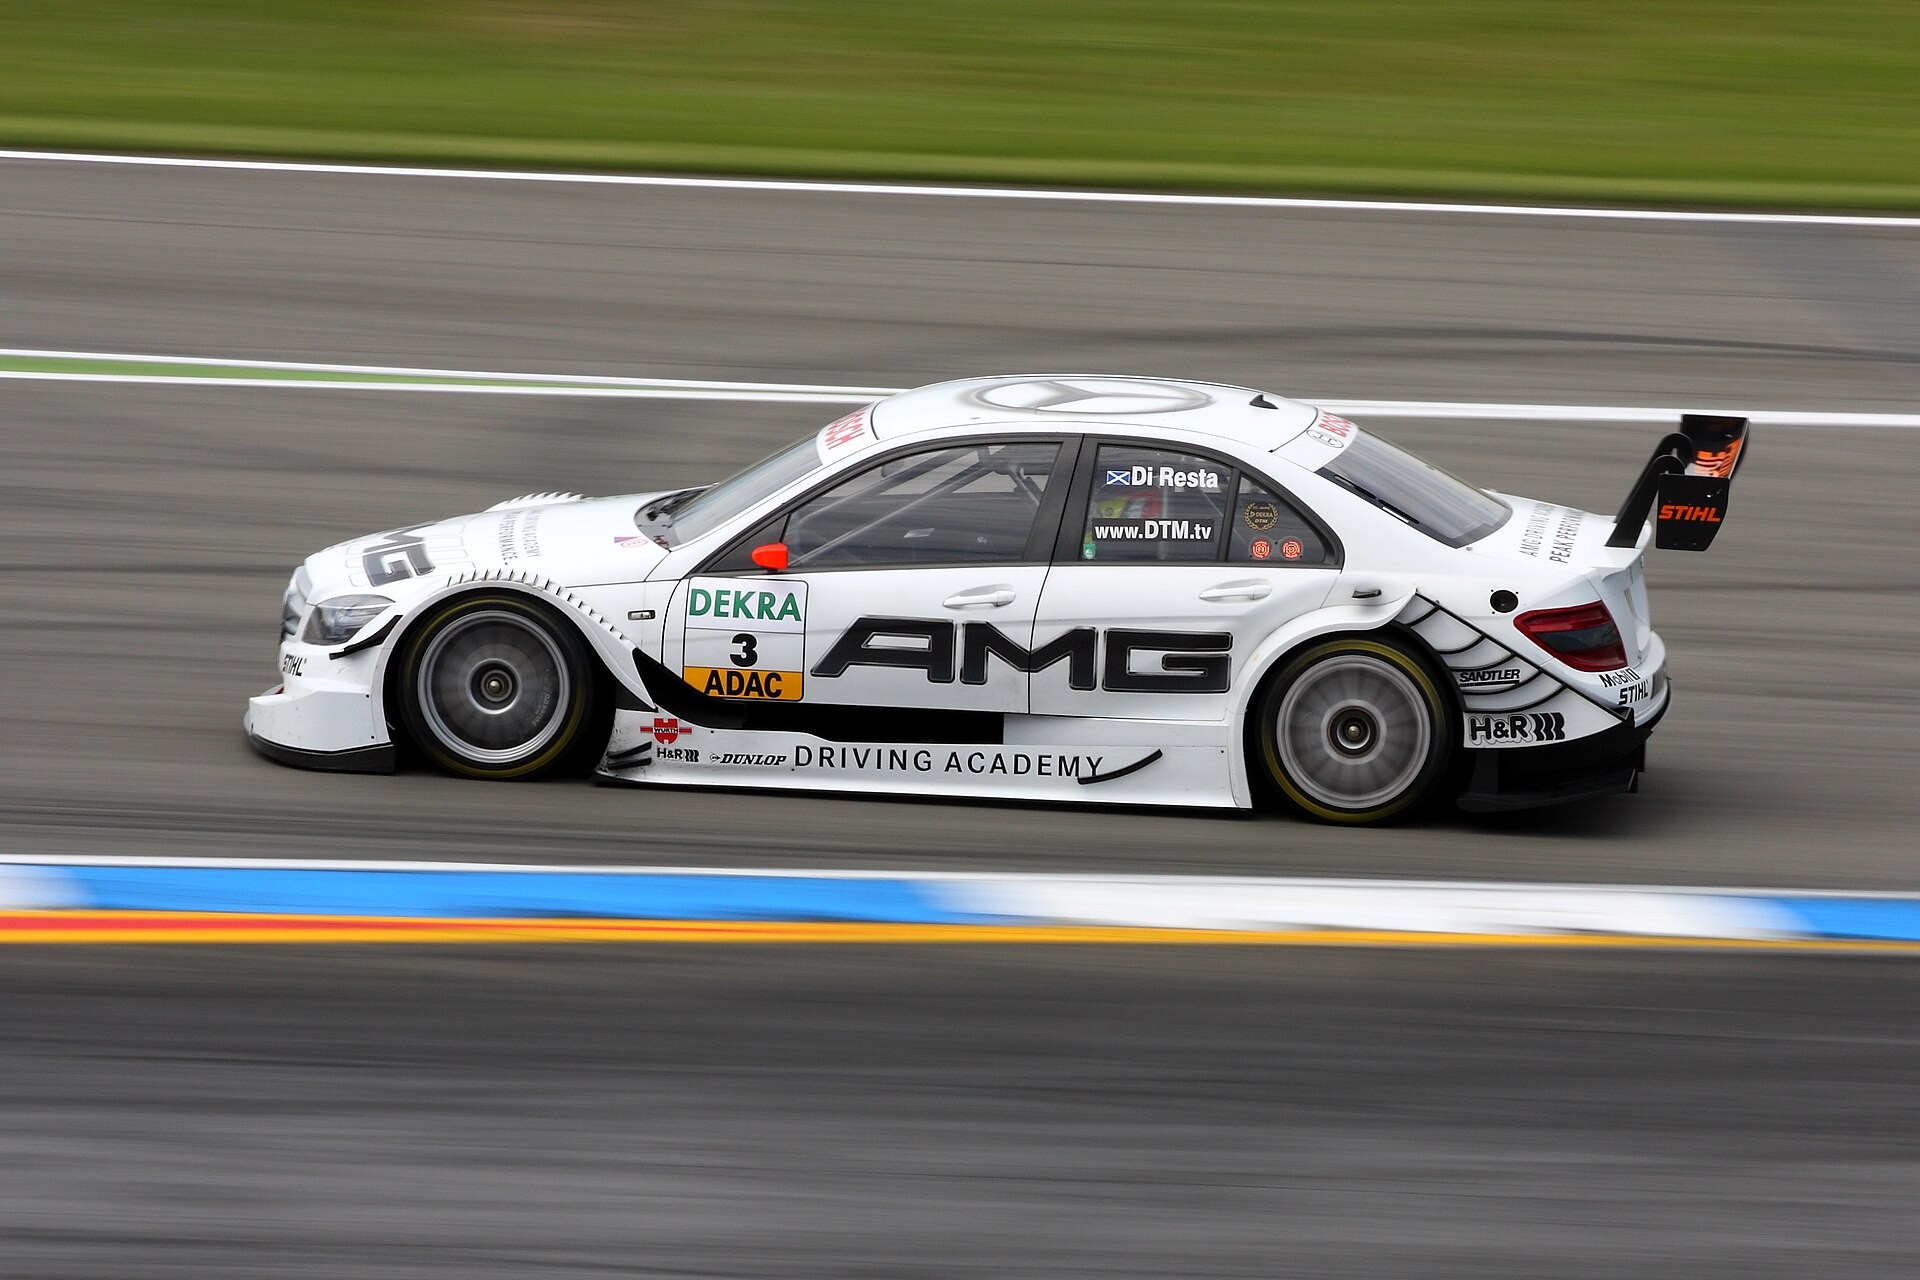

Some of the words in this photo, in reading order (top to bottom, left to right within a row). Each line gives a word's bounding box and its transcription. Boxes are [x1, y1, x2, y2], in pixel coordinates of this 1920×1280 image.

[1131, 466, 1153, 486] Di
[1159, 467, 1219, 488] Resta
[1659, 504, 1720, 522] STIHL
[1095, 521, 1212, 539] www.DTM.tv
[1519, 539, 1541, 557] AMG
[1549, 540, 1574, 564] PEAK
[689, 588, 802, 621] DEKRA
[730, 633, 758, 667] 3
[810, 615, 1232, 694] AMG
[704, 670, 782, 698] ADAC
[1460, 669, 1520, 682] SANDTLER
[1618, 680, 1648, 705] STIHL
[1469, 713, 1529, 742] H&R
[657, 748, 682, 760] H&R
[720, 753, 787, 765] DUNLOP
[795, 745, 933, 772] DRIVING
[945, 751, 1104, 777] ACADEMY
